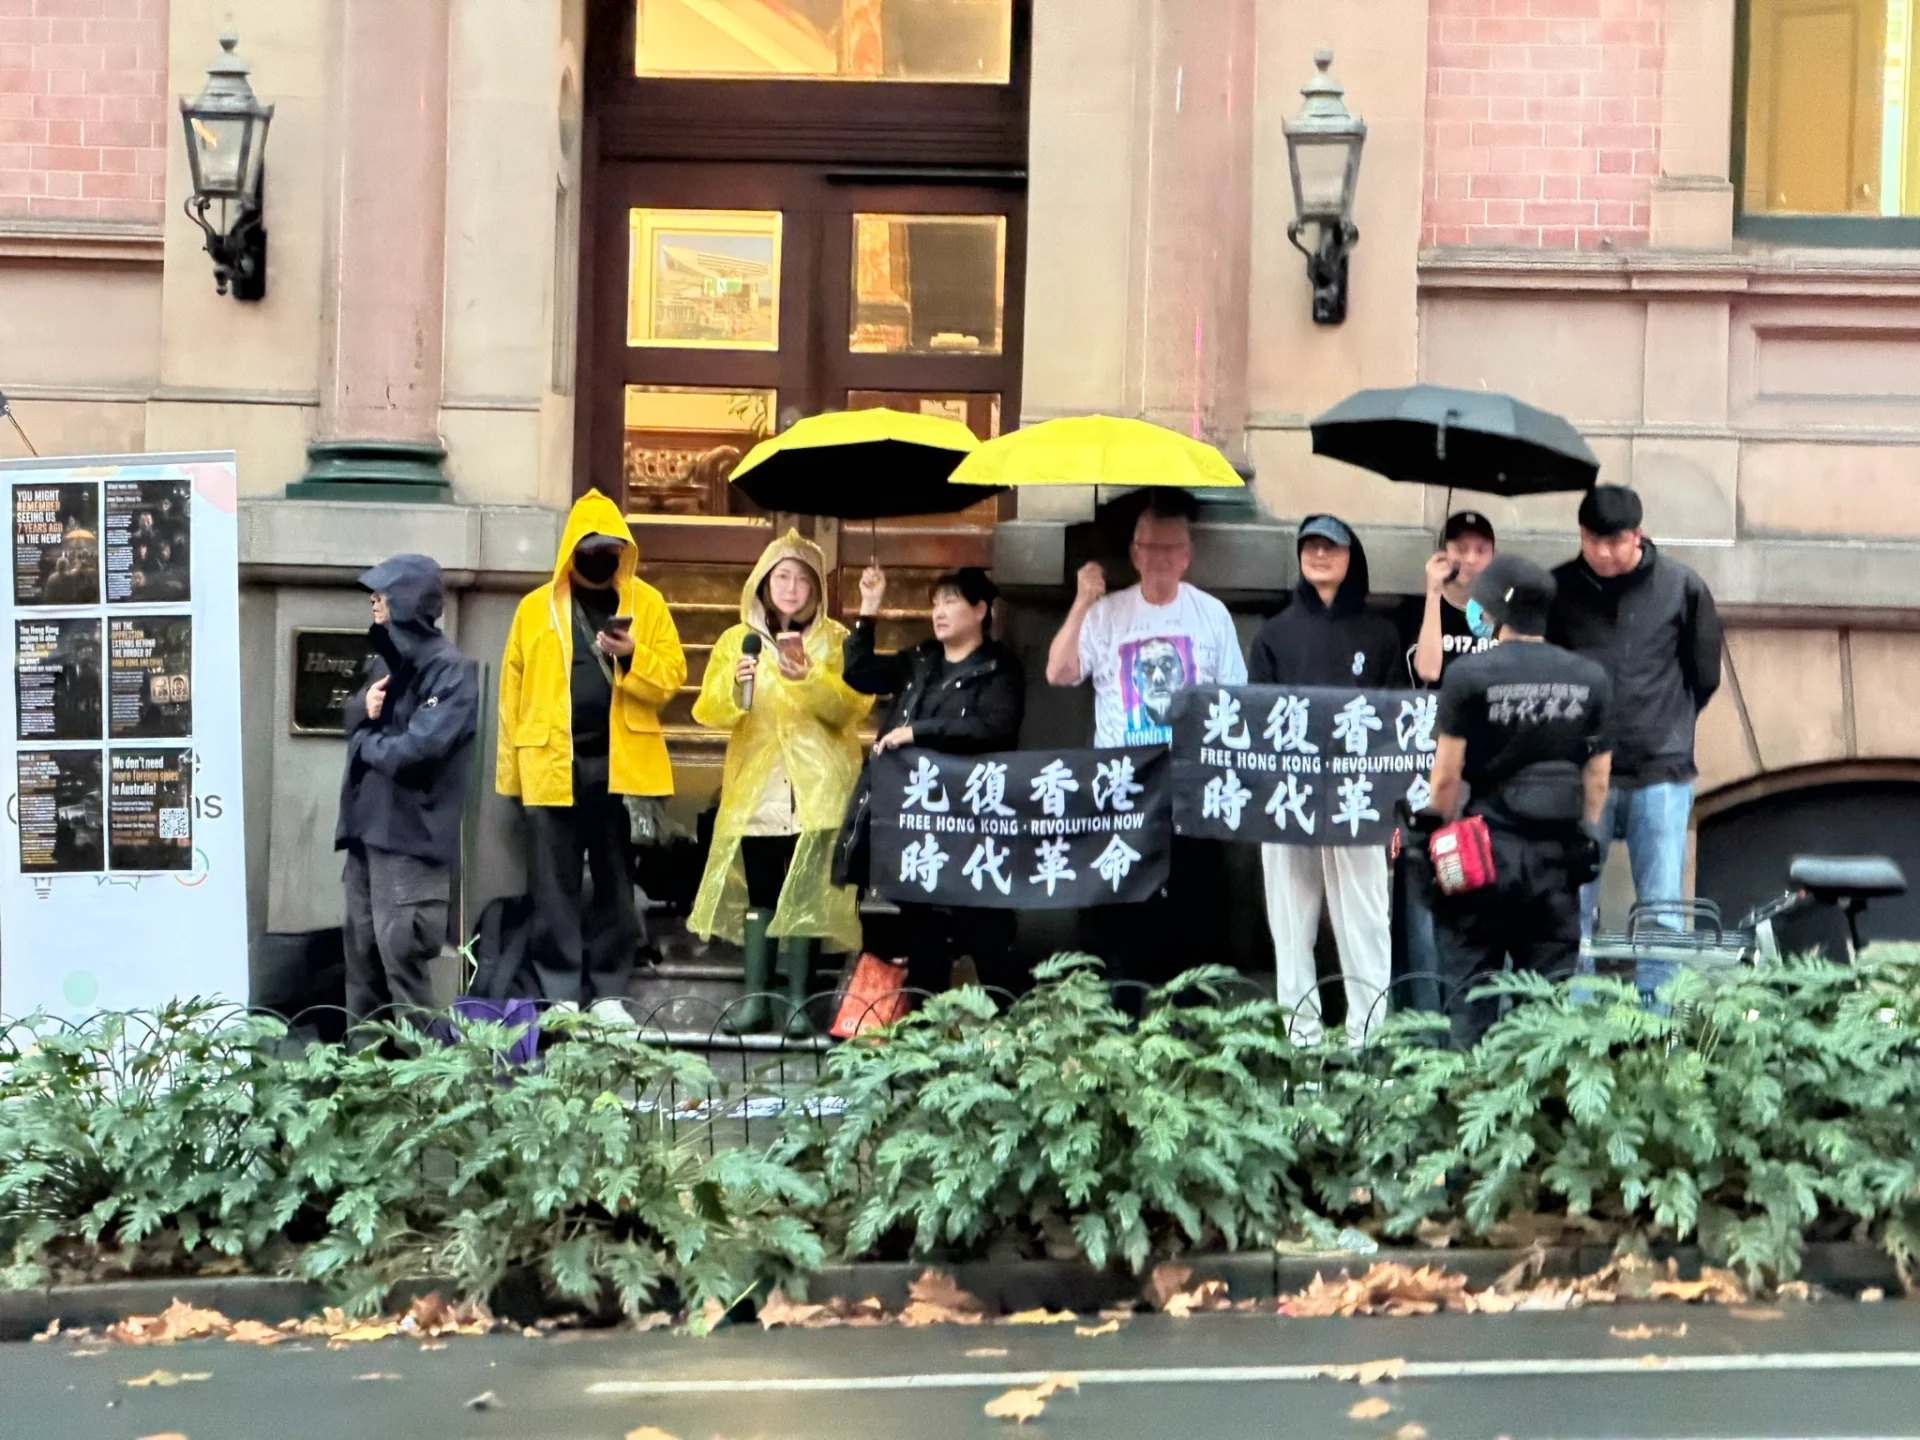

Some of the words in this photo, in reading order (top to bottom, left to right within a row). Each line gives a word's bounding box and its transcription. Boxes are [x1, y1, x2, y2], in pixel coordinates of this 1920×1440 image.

[17, 490, 32, 501] YOU
[34, 490, 60, 501] MIGHT
[17, 501, 60, 511] REMEMBER
[17, 512, 44, 522] SEEING
[45, 512, 56, 522] US
[24, 523, 48, 534] YEARS
[48, 522, 63, 533] AGO
[17, 535, 25, 544] IN
[26, 534, 38, 544] THE
[41, 534, 62, 544] NEWS
[303, 652, 357, 677] Hong
[112, 756, 124, 769] We
[125, 756, 144, 769] don't
[145, 756, 164, 768] need
[1200, 747, 1232, 768] FREE
[1237, 752, 1277, 771] HONG
[1282, 755, 1321, 774] KONG
[1332, 754, 1414, 774] REVOLUTION
[1416, 753, 1436, 771] NO
[112, 771, 131, 781] more
[133, 770, 158, 782] foreign
[160, 770, 179, 782] spies
[112, 784, 119, 795] in
[120, 783, 156, 795] Australia!
[901, 756, 1145, 818] 光復香港
[899, 813, 931, 829] FREE
[936, 814, 976, 833] HONG
[980, 817, 1019, 836] KONG
[1030, 814, 1111, 836] REVOLUTION
[1113, 812, 1145, 831] NOW
[899, 832, 1142, 898] 時代革命
